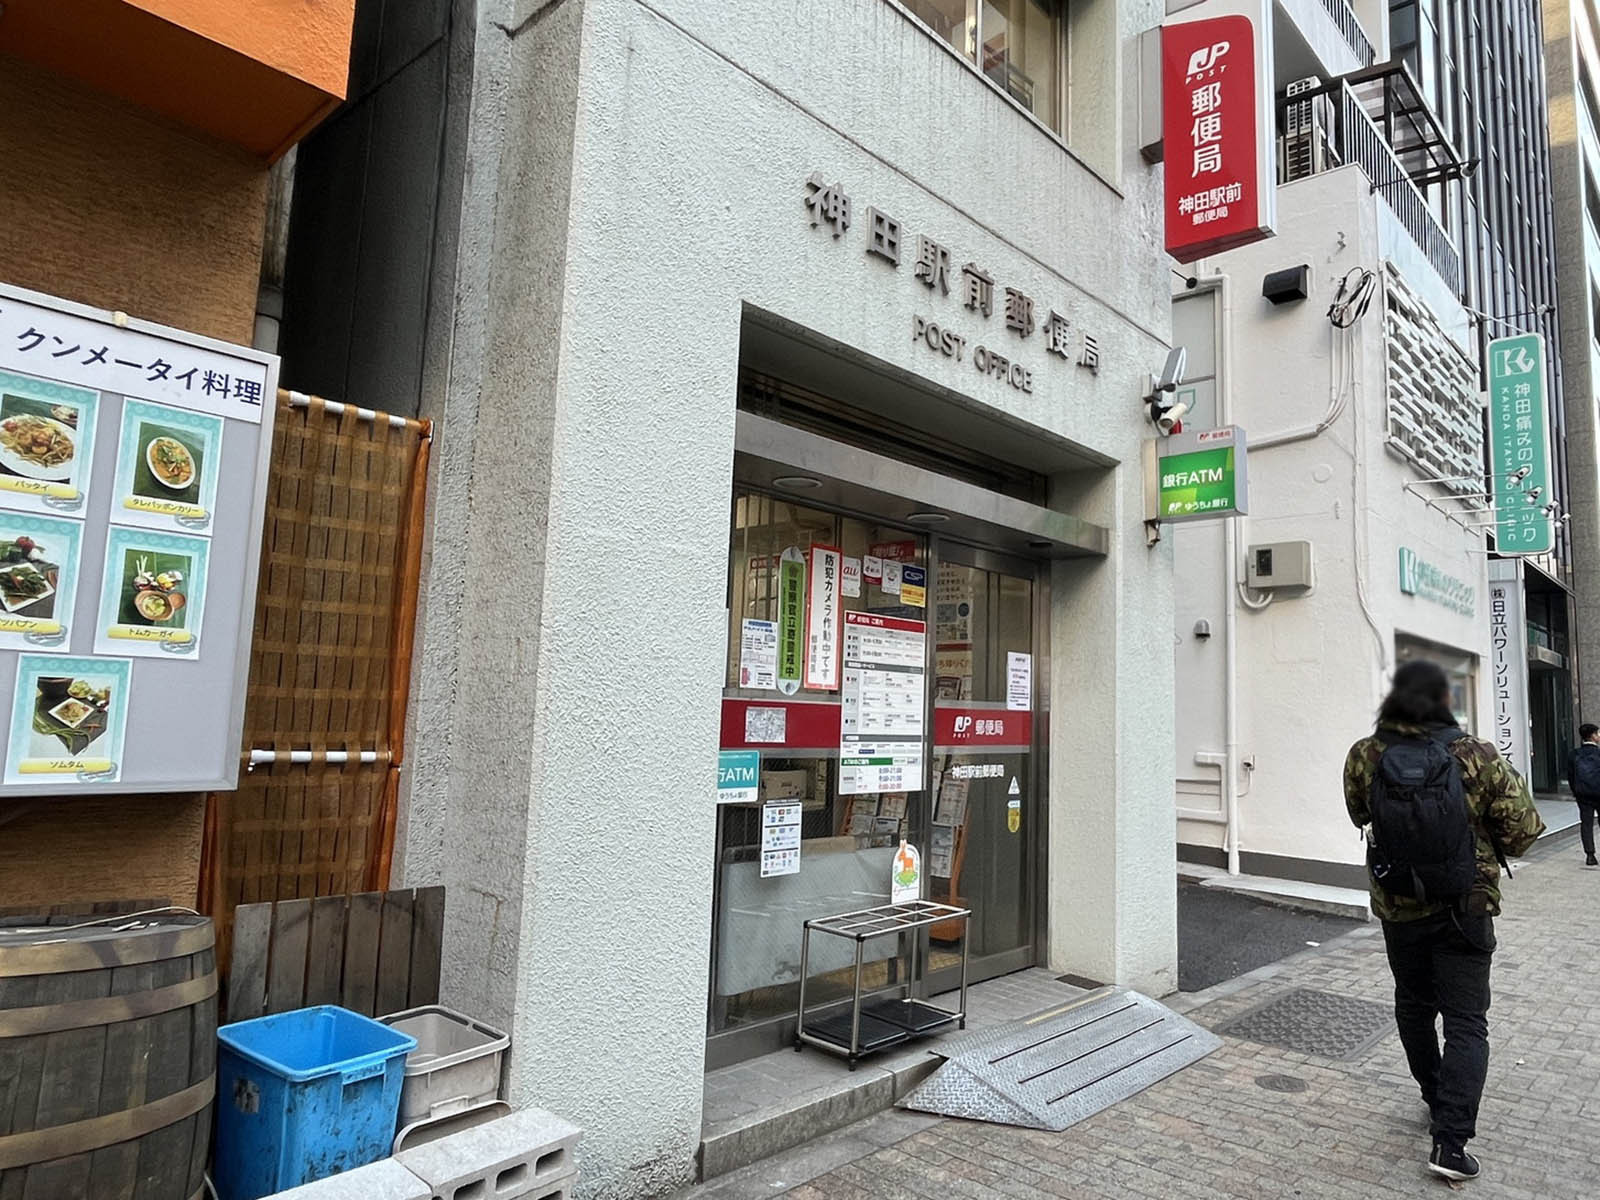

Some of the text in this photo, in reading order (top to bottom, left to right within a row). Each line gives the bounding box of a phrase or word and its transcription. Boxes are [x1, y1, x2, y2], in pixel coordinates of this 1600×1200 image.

[1185, 64, 1227, 86] POST
[1191, 81, 1222, 179] 郵便局
[1178, 182, 1242, 216] 神田駅前
[1192, 206, 1228, 226] 郵便局
[804, 170, 1103, 377] 神田駅前郵便局
[17, 327, 263, 407] クンメータイ料理
[913, 315, 1034, 395] POST OFFICE
[1501, 387, 1512, 430] KANDA
[1162, 467, 1223, 488] 銀行ATM
[1185, 497, 1229, 512] ゆうちょ銀行
[843, 566, 859, 577] au
[976, 719, 1004, 736] 郵便局
